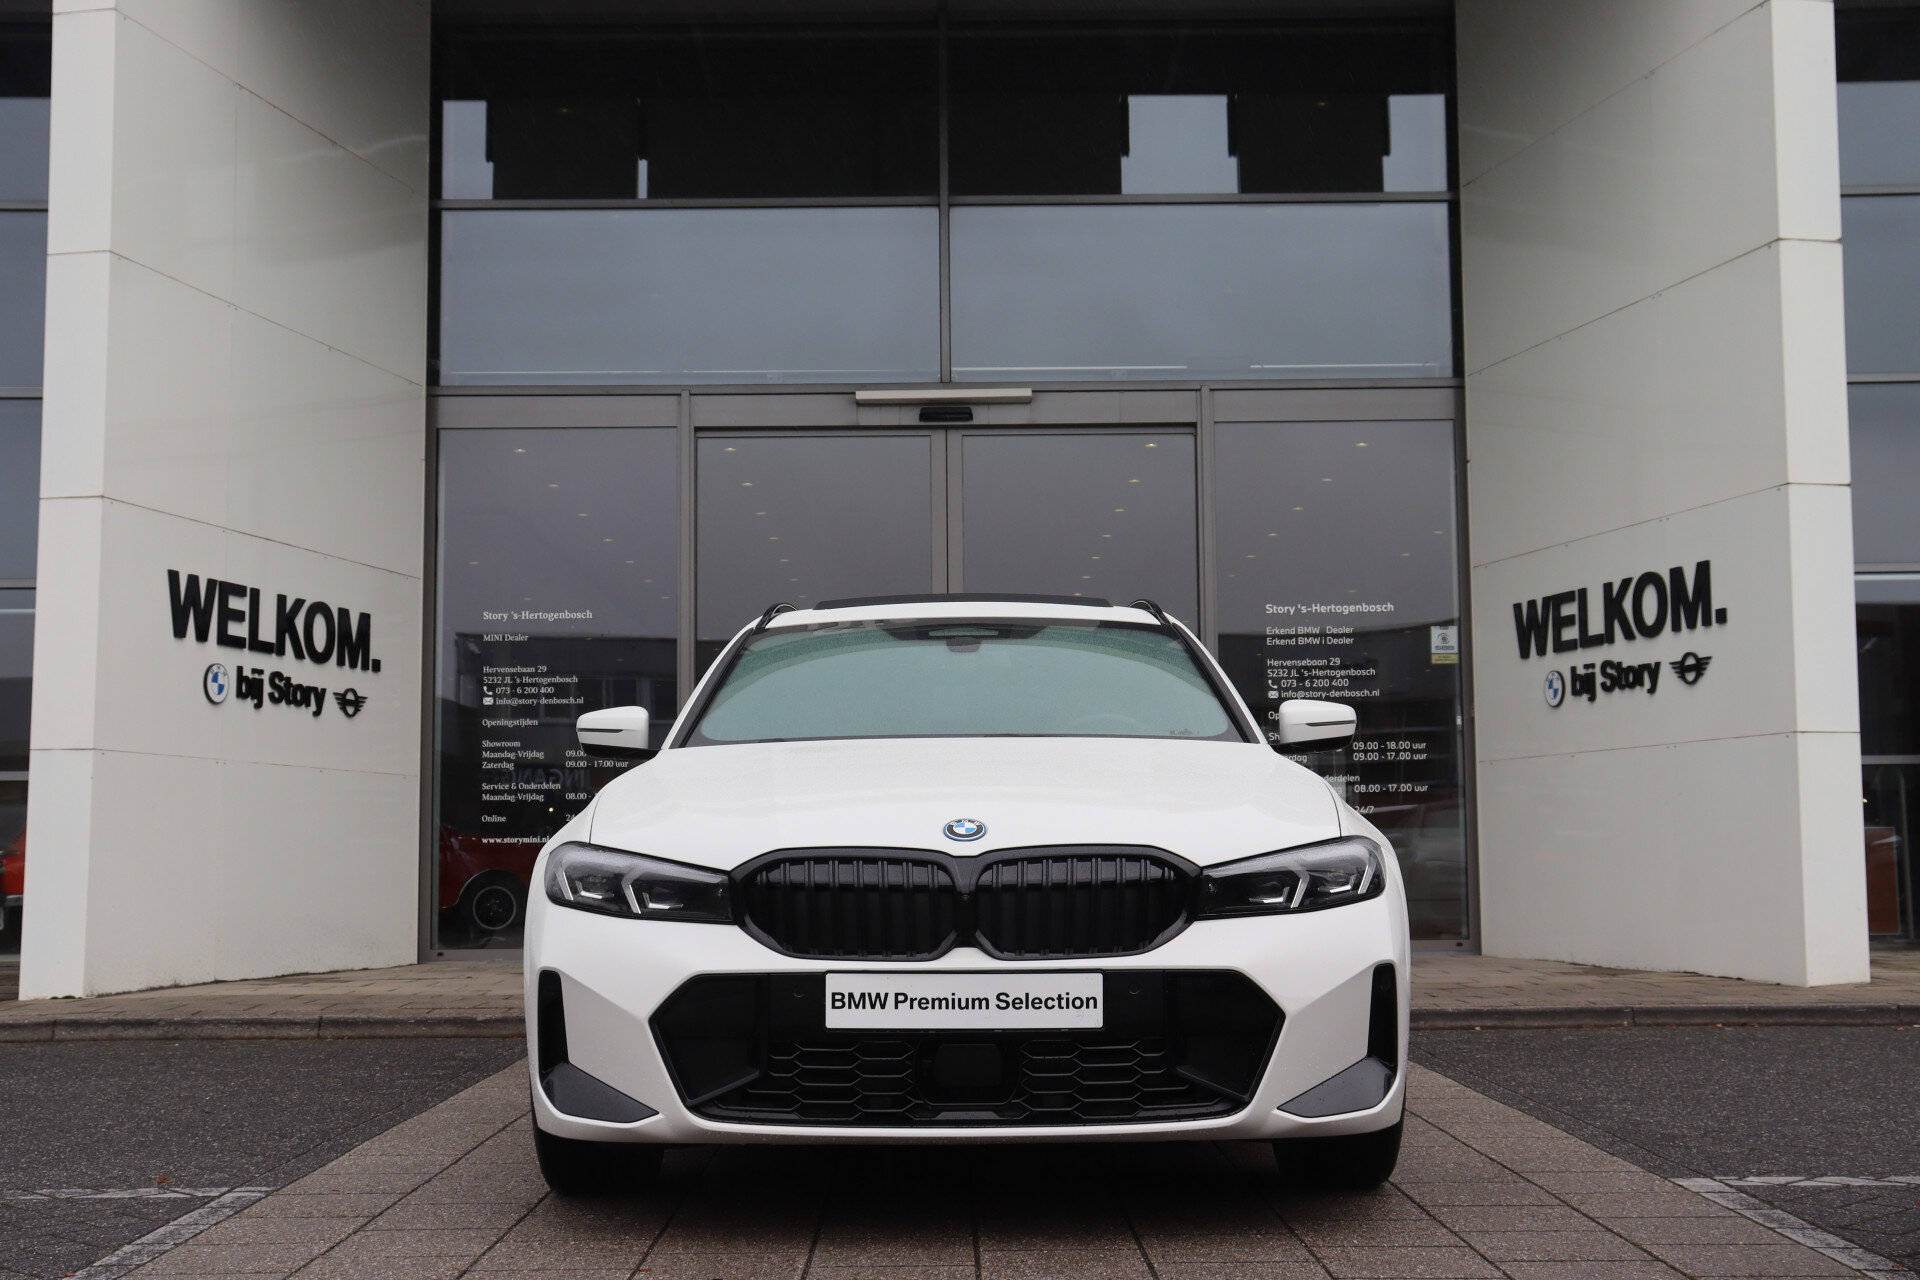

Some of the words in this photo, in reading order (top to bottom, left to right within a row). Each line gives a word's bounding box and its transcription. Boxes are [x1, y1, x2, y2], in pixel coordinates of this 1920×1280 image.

[1265, 604, 1295, 615] Story
[1297, 602, 1394, 614] 's-Hertogenbosch
[1513, 560, 1727, 660] WELKOM.
[483, 611, 508, 622] Story
[511, 610, 593, 622] 's-Hertogenbosch
[167, 569, 382, 673] WELKOM.
[1266, 627, 1296, 635] Erkend
[1297, 626, 1320, 634] BMW
[1326, 626, 1354, 634] Dealer
[504, 633, 529, 642] Dealer
[1266, 637, 1296, 645] Erkend
[1297, 637, 1320, 645] BMW
[1326, 636, 1354, 645] Dealer
[1267, 658, 1328, 666] Hervensebaan
[1329, 657, 1341, 666] 29
[1267, 669, 1289, 677] 5232
[1290, 668, 1299, 677] JL
[1301, 667, 1376, 678] 's-Hertogenbosch
[483, 676, 502, 684] 5232
[503, 676, 513, 684] JL
[515, 675, 578, 684] 's-Hertogenbosch
[1281, 679, 1297, 687] 073
[1305, 679, 1311, 687] 6
[1312, 679, 1330, 687] 200
[1331, 679, 1349, 687] 400
[1570, 662, 1597, 702] bij
[1600, 660, 1661, 695] Story
[236, 665, 264, 710] bij
[267, 671, 327, 717] Story
[496, 686, 511, 694] 073
[516, 686, 522, 694] 6
[524, 686, 538, 694] 200
[539, 686, 554, 694] 400
[1281, 689, 1380, 699] info@story-denbosch.nl
[496, 697, 584, 706] info@story-denbosch.nl
[482, 718, 538, 728] Openingstijden
[1353, 741, 1378, 750] 09.00
[1386, 741, 1410, 749] 18.00
[482, 750, 544, 759] Maandag-Vrijdag
[1353, 752, 1379, 760] 09.00
[482, 761, 514, 770] Zaterdag
[594, 760, 614, 768] 17.00
[482, 782, 509, 790] Service
[511, 782, 517, 790] &
[518, 782, 561, 790] Onderdelen
[1354, 784, 1380, 793] 08.00
[482, 793, 544, 802] Maandag-Vrijdag
[481, 814, 507, 823] Online
[831, 992, 889, 1010] BMW
[894, 992, 990, 1010] Premium
[995, 991, 1098, 1010] Selection
